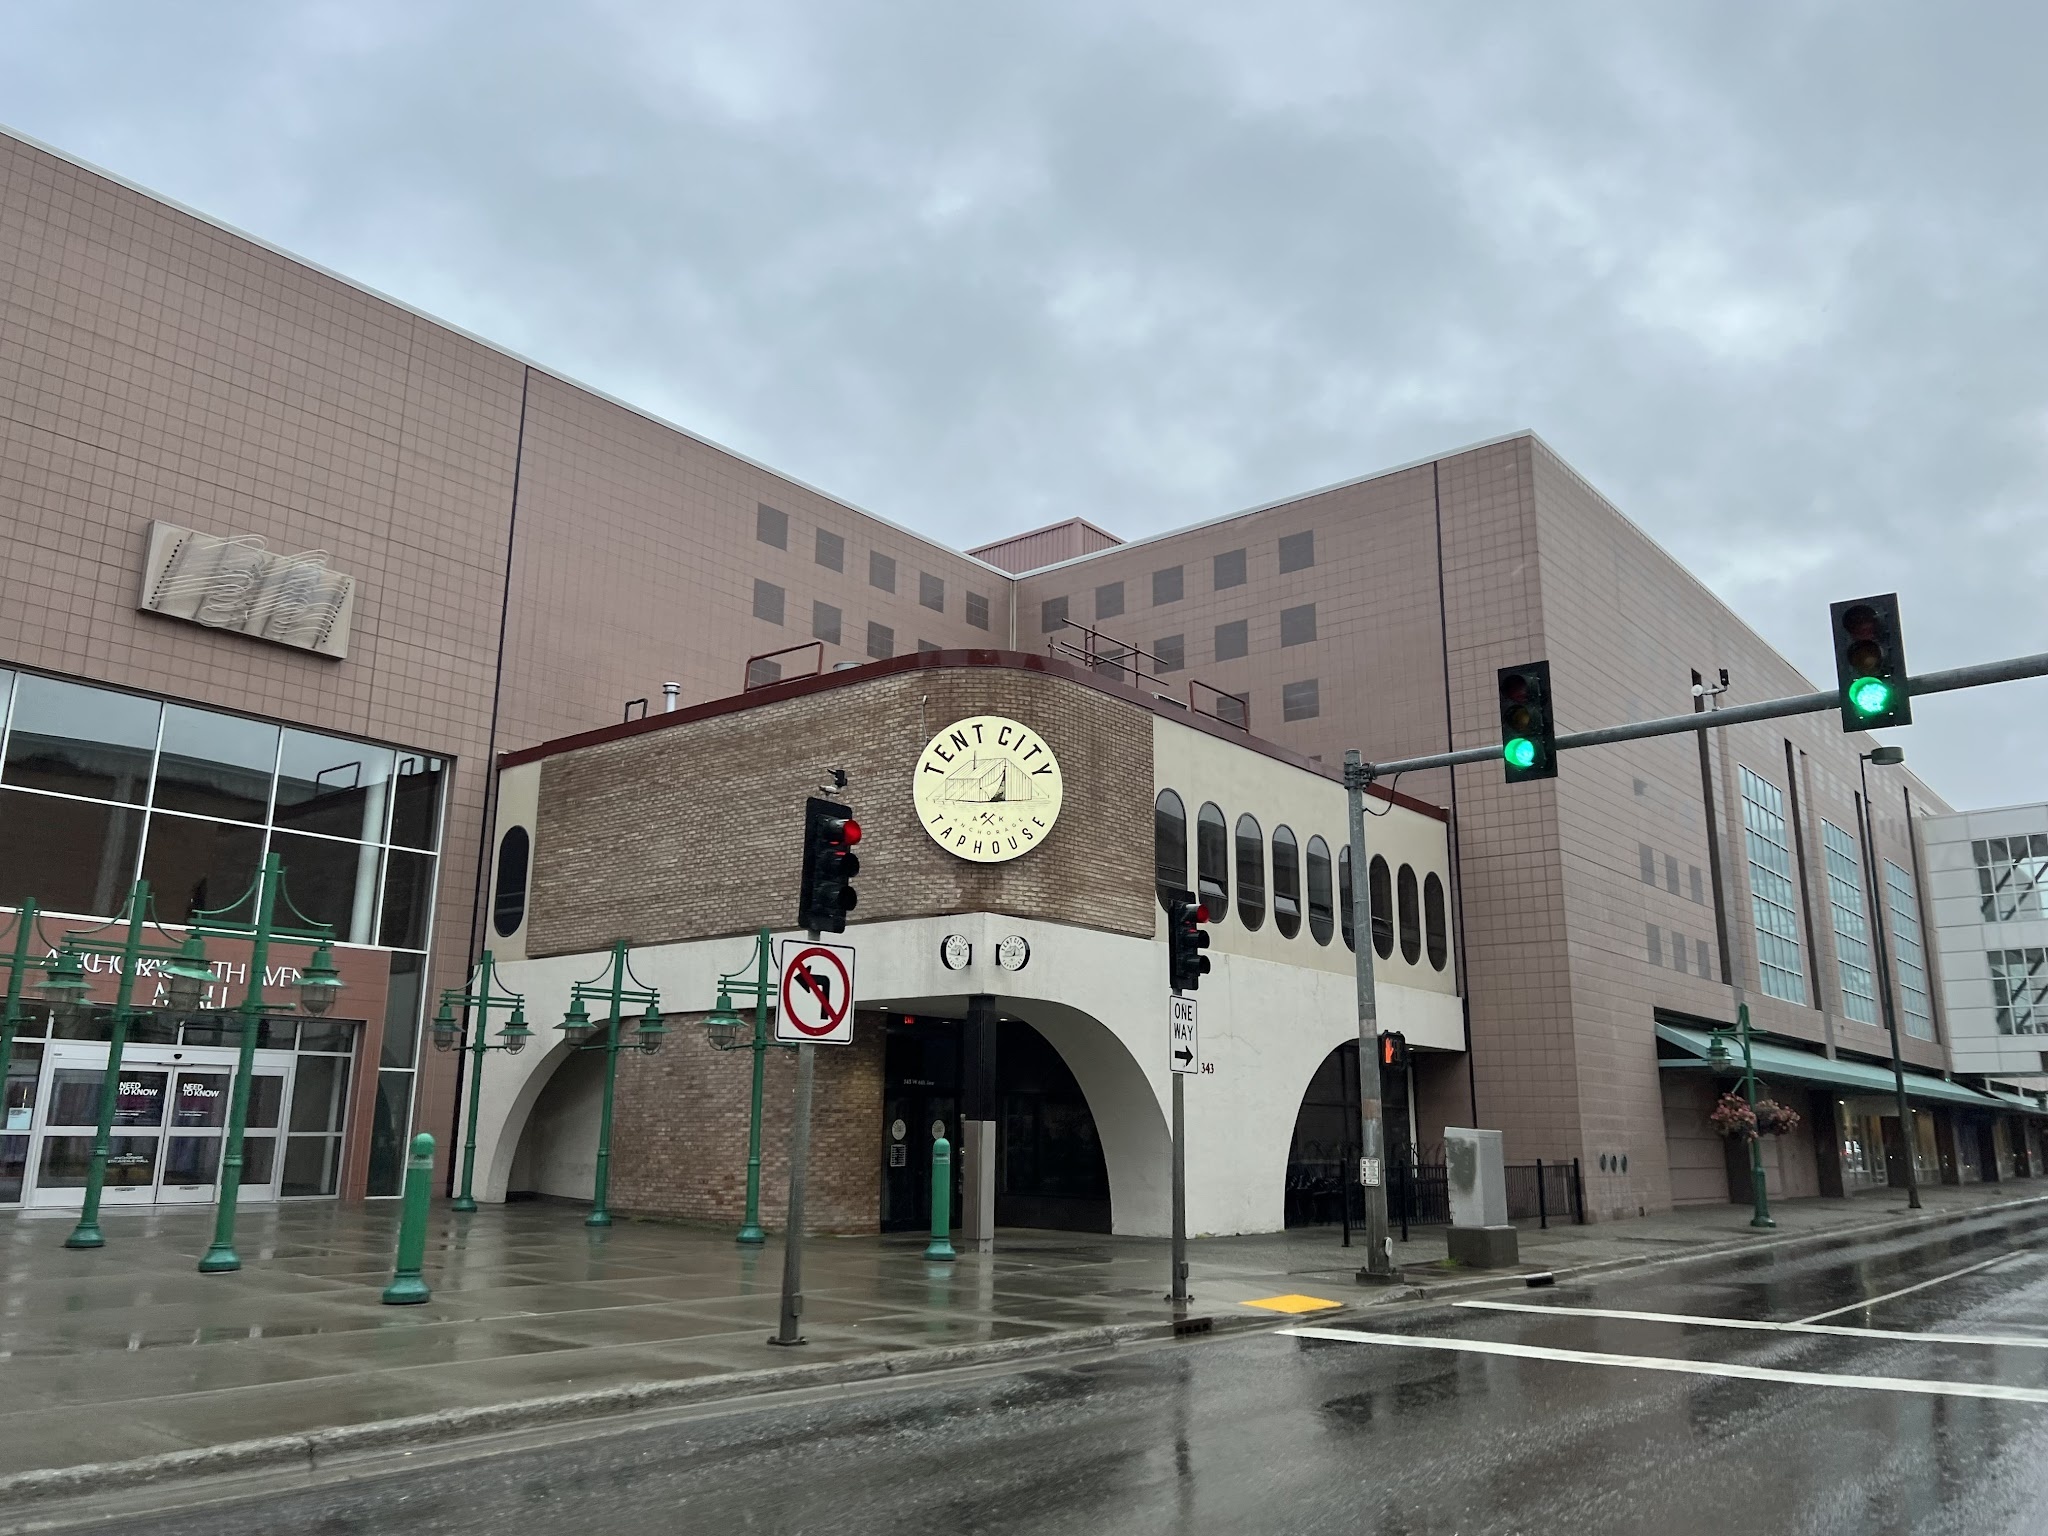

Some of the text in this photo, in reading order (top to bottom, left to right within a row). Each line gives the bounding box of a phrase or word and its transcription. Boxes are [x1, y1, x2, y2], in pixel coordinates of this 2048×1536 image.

[924, 724, 1053, 777] TENT CITY
[931, 814, 1046, 855] TAPHOUSE
[953, 817, 1024, 836] ANCHORAGE
[1174, 1002, 1193, 1021] ONE
[1173, 1022, 1194, 1041] WAY
[1201, 1062, 1215, 1075] 343
[119, 1081, 141, 1089] NEED
[119, 1088, 158, 1097] TO KNOW
[182, 1089, 220, 1098] TO KNOW
